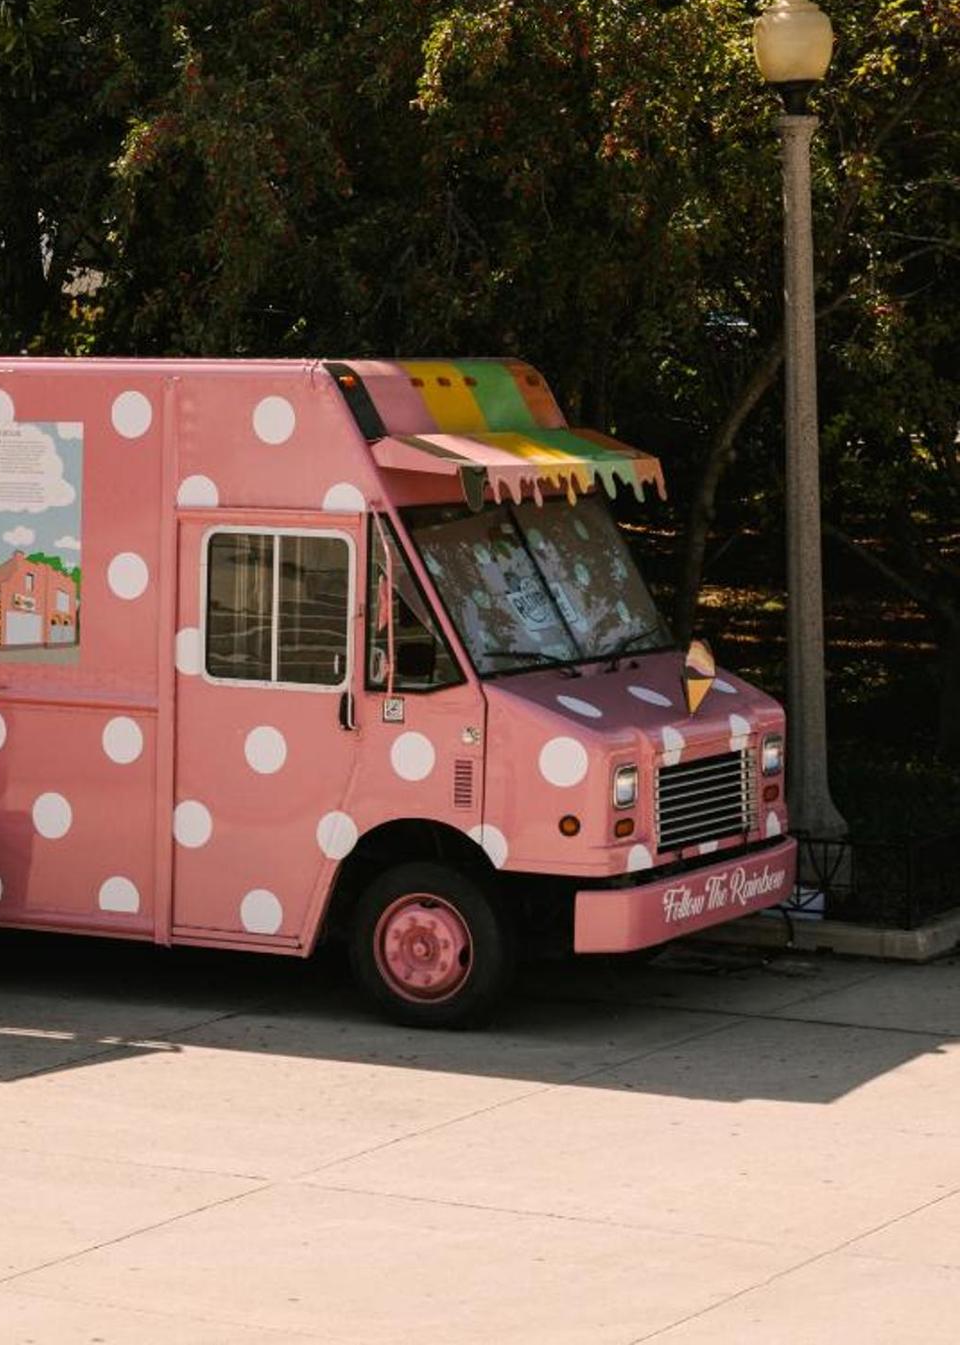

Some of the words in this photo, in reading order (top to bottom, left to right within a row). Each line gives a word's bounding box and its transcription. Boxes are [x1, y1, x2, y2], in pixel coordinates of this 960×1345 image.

[663, 885, 705, 923] Follow
[705, 872, 728, 910] The
[729, 865, 785, 906] Rainbow
